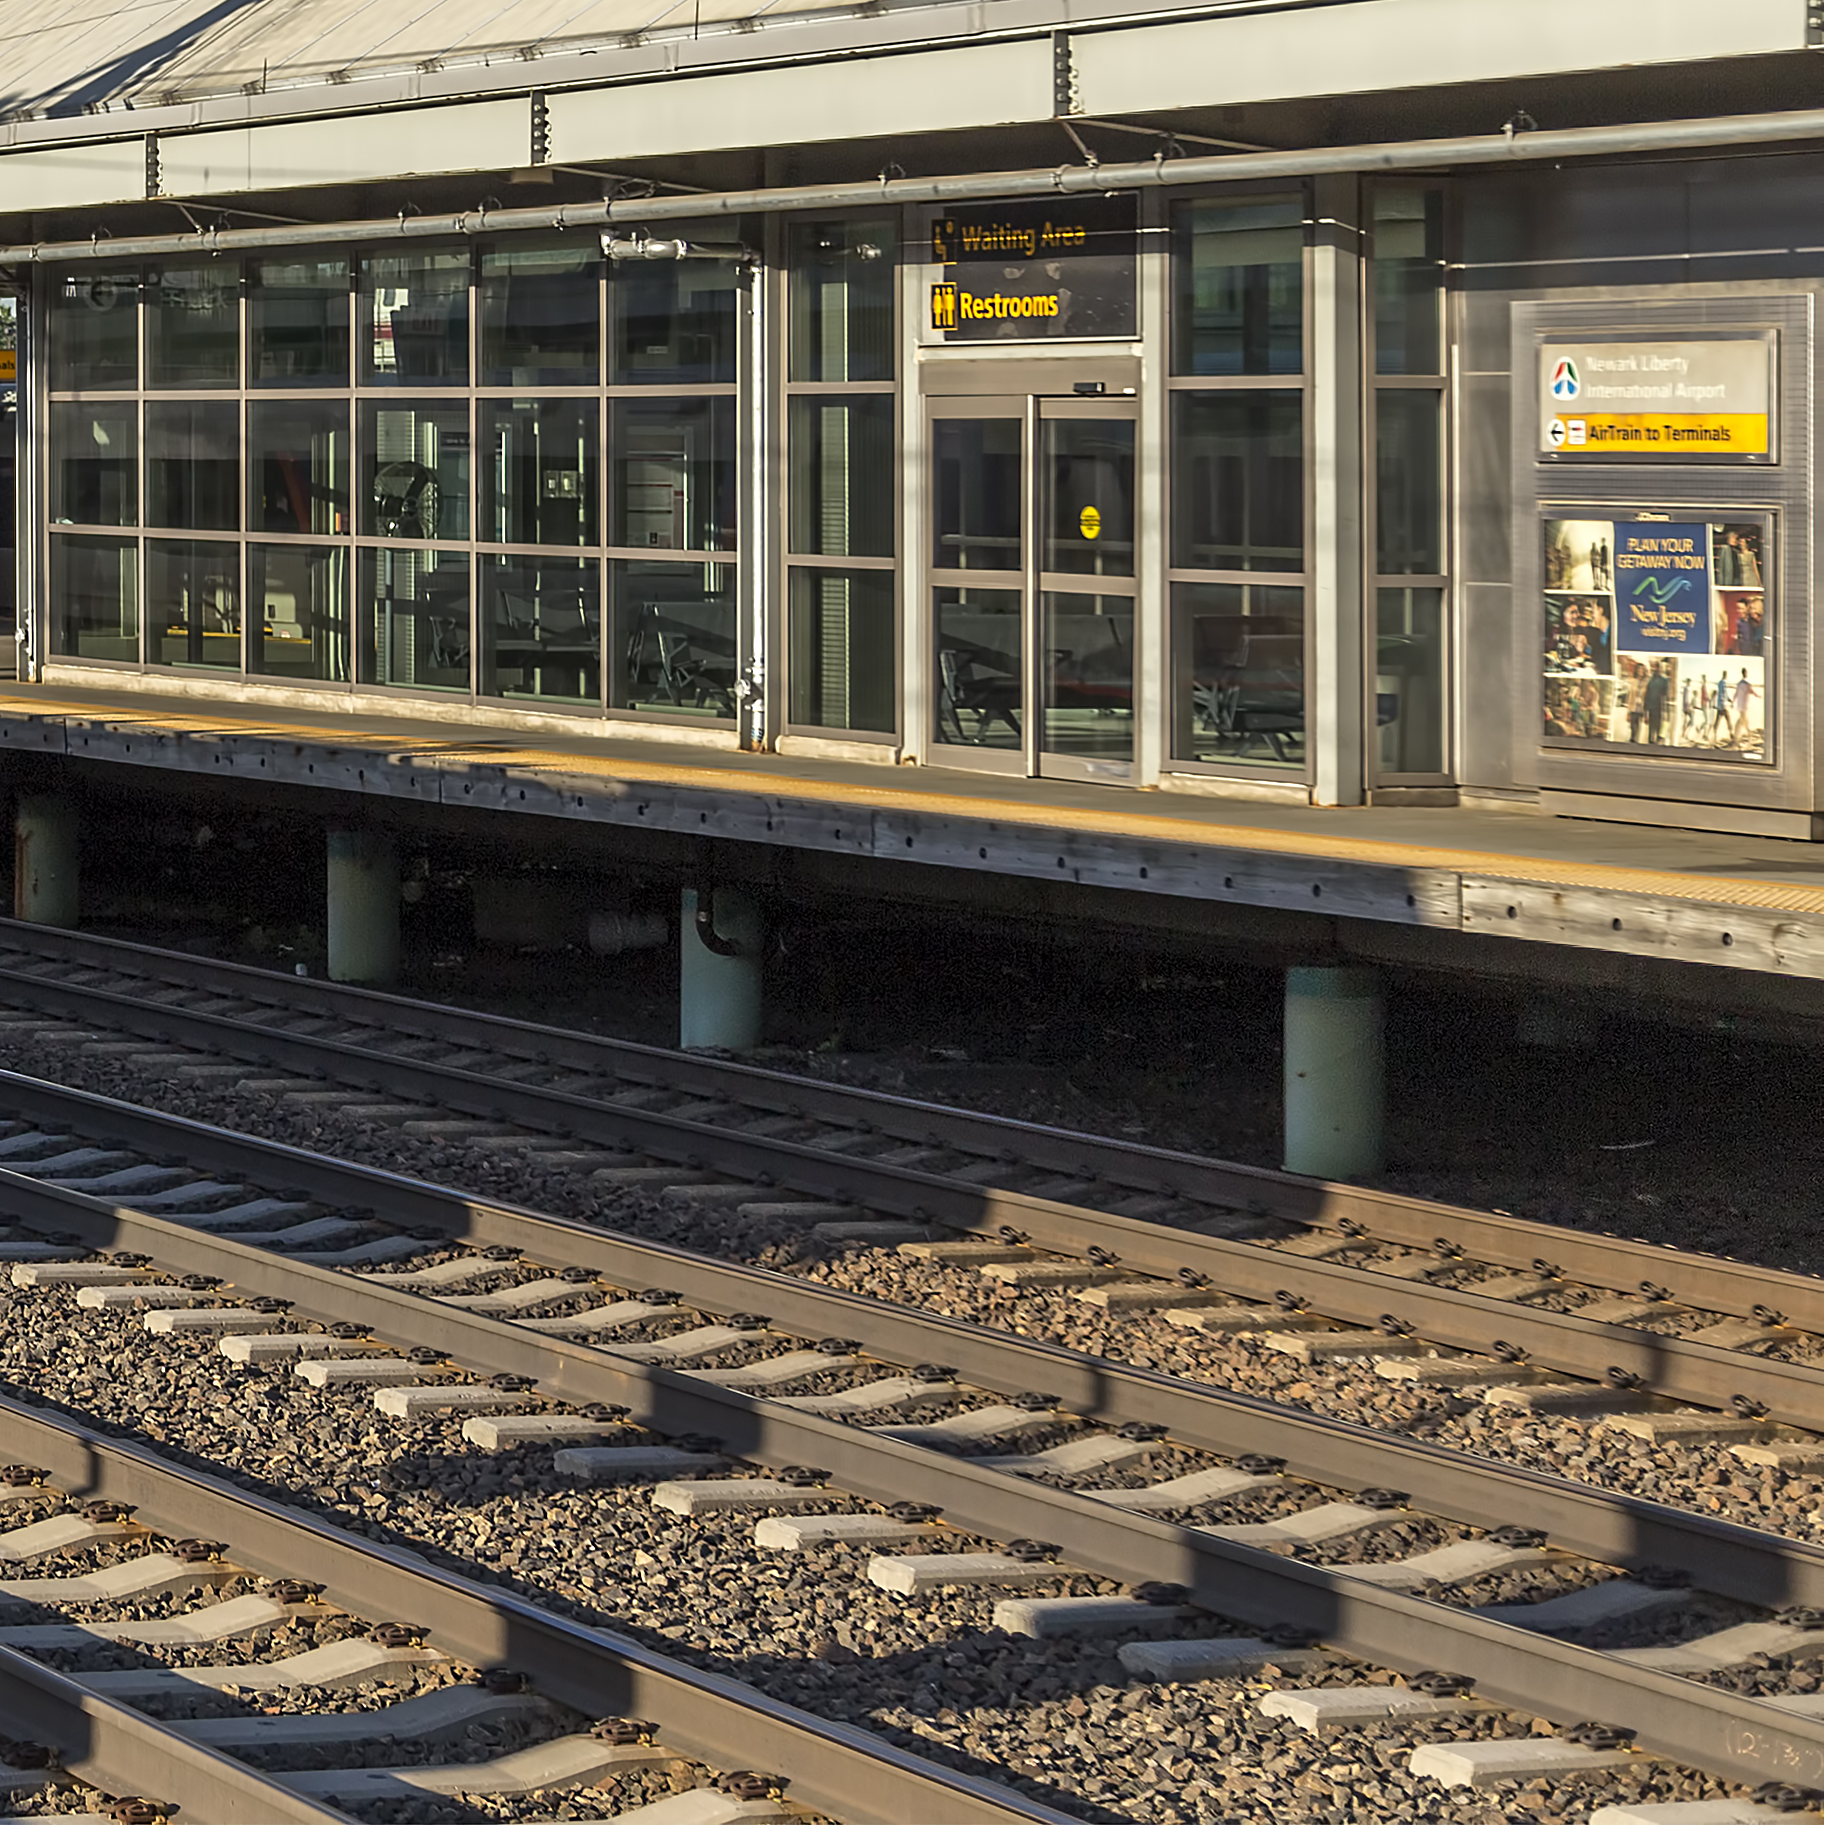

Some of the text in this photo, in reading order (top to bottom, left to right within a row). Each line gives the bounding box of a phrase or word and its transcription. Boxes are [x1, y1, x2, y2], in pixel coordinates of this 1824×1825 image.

[962, 222, 1086, 256] Waiting Area
[960, 292, 1059, 319] Restrooms
[1586, 355, 1690, 374] Newark Liberty
[1586, 382, 1725, 402] International Airport
[1589, 425, 1731, 441] AirTrain to Terminals
[1627, 538, 1694, 552] PLAN YOUR
[1617, 554, 1706, 569] GETAWAY NOW
[1630, 604, 1697, 628] New Jersey
